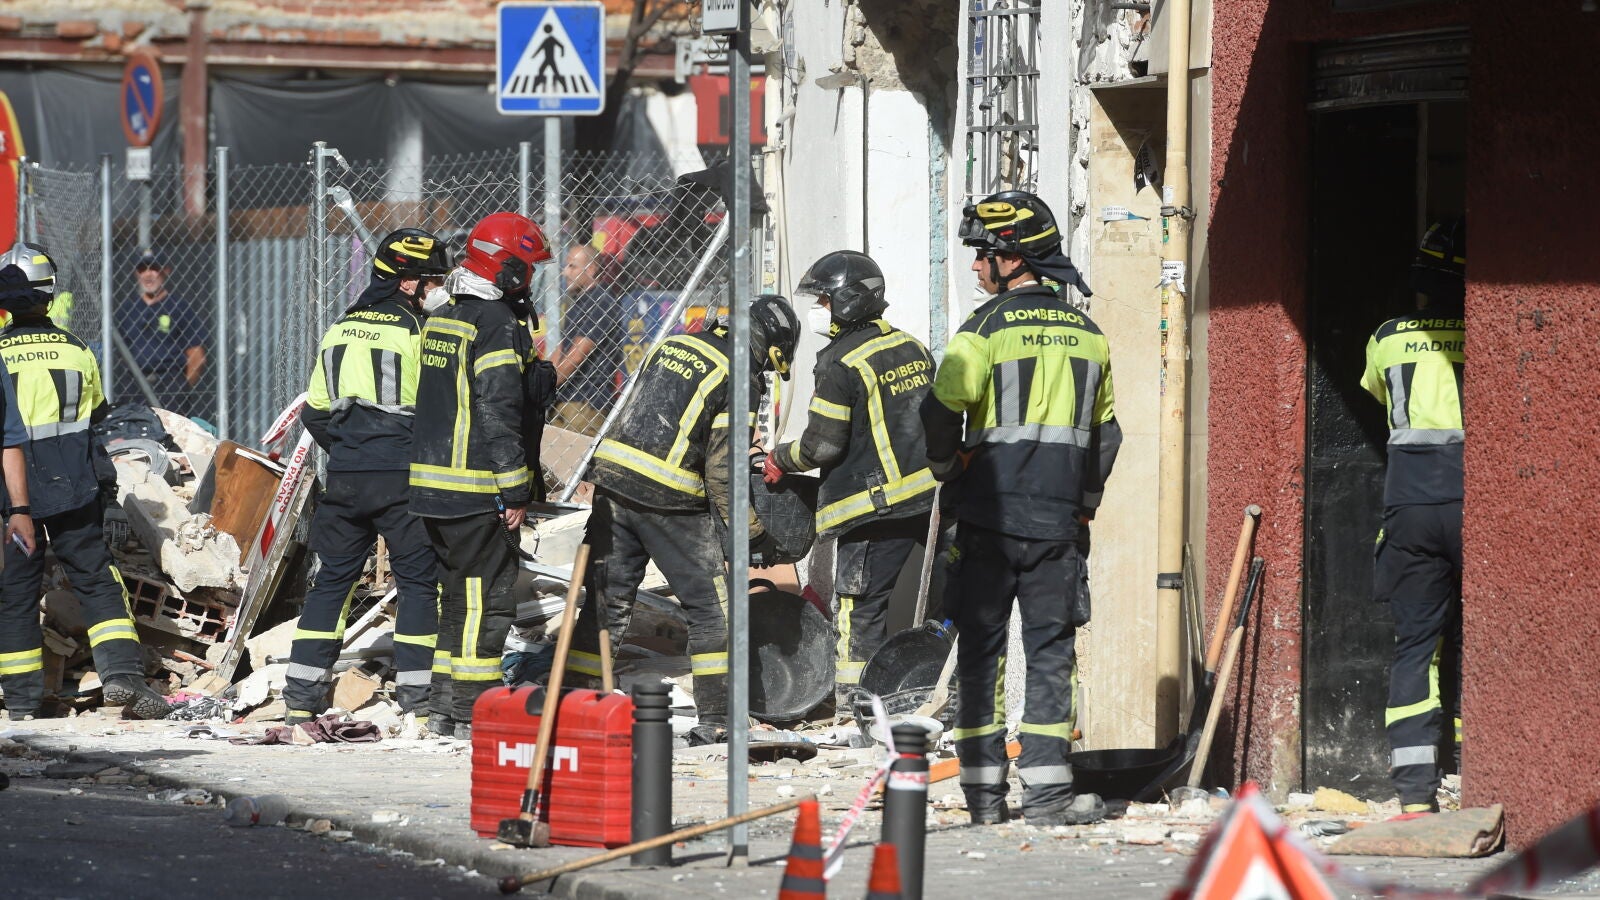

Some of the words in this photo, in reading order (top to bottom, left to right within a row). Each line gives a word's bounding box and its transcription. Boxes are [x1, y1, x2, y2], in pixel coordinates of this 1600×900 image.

[1003, 308, 1085, 326] BOMBEROS
[1395, 319, 1464, 331] BOMBER
[0, 333, 68, 348] OMBEROS
[341, 328, 381, 341] MADRID
[1021, 334, 1079, 347] MADRID
[4, 351, 59, 366] MADRID
[889, 373, 930, 396] MADRI
[294, 446, 306, 464] NO
[275, 466, 297, 503] PASAR
